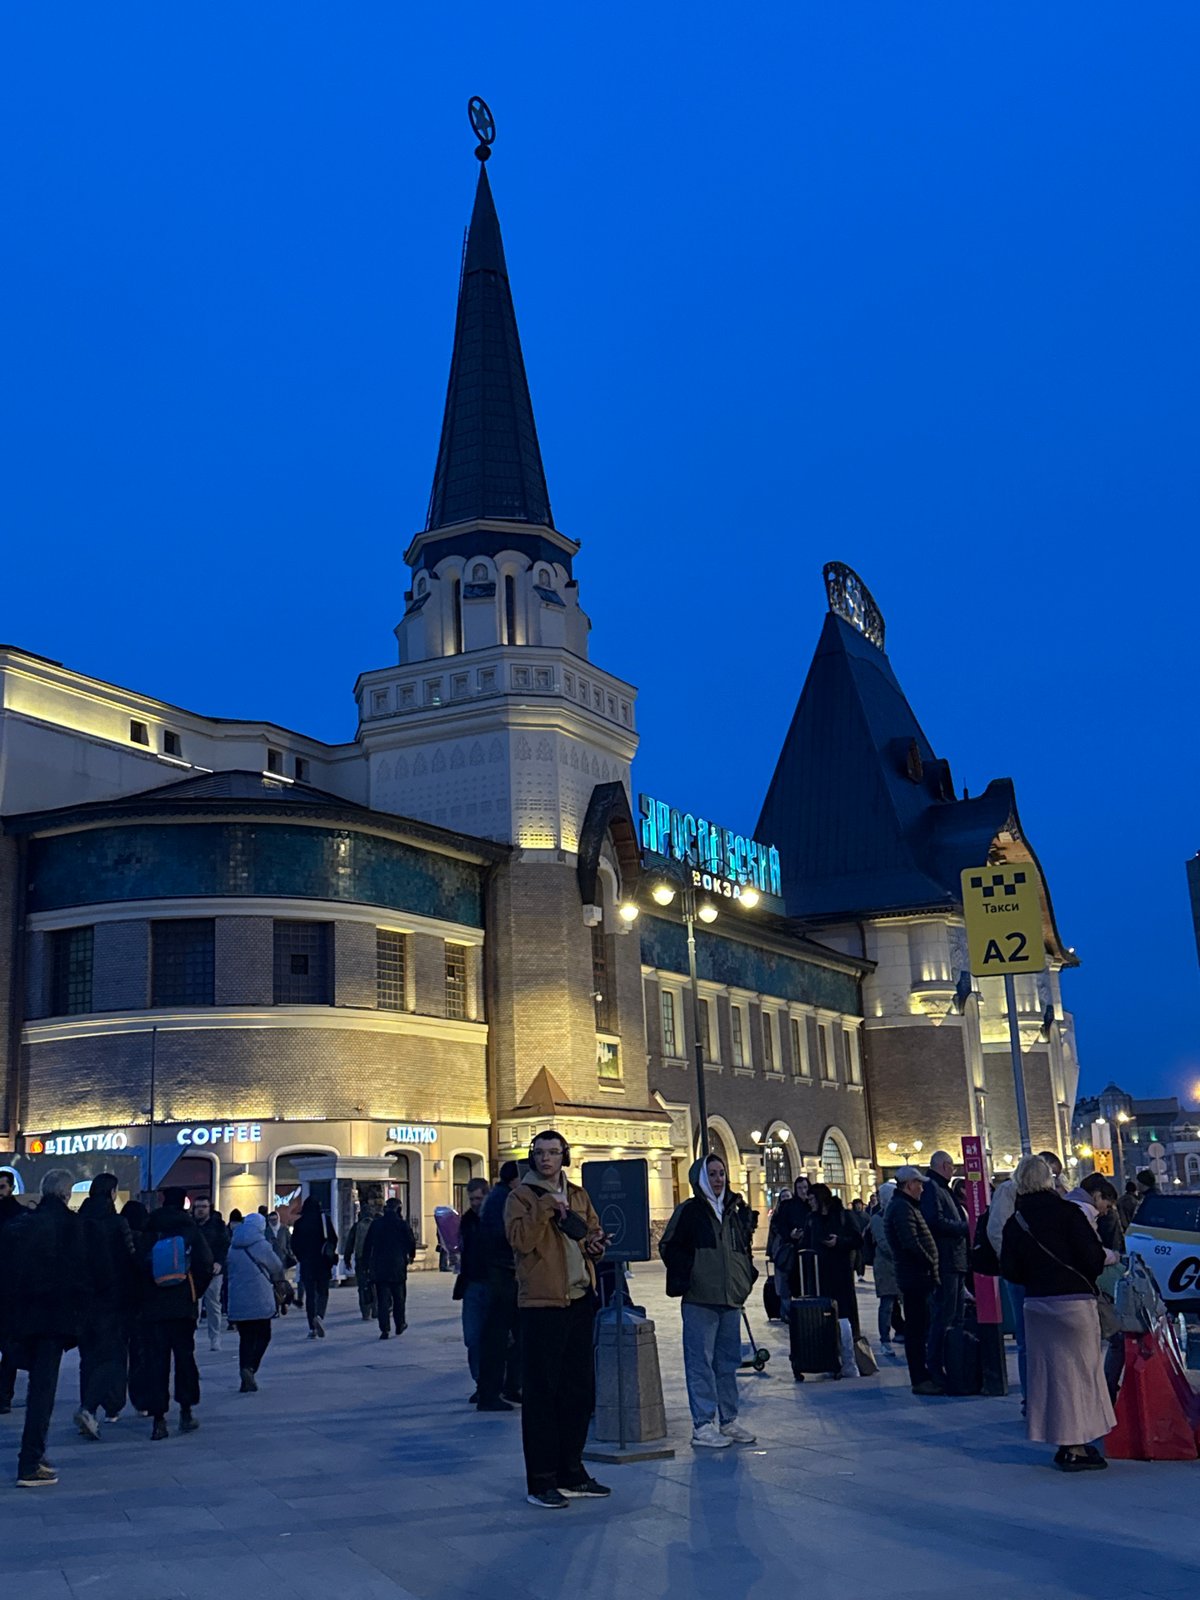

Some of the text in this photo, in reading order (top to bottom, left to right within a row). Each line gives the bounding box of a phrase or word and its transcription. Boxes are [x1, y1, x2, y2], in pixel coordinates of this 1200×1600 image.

[692, 870, 742, 899] ВОКЗА
[982, 902, 1019, 914] Такси
[983, 932, 1029, 964] А2
[55, 1132, 128, 1155] ПАТИО
[176, 1125, 261, 1145] COFFEE
[397, 1126, 437, 1143] ПАТИО
[1154, 1245, 1172, 1256] 692
